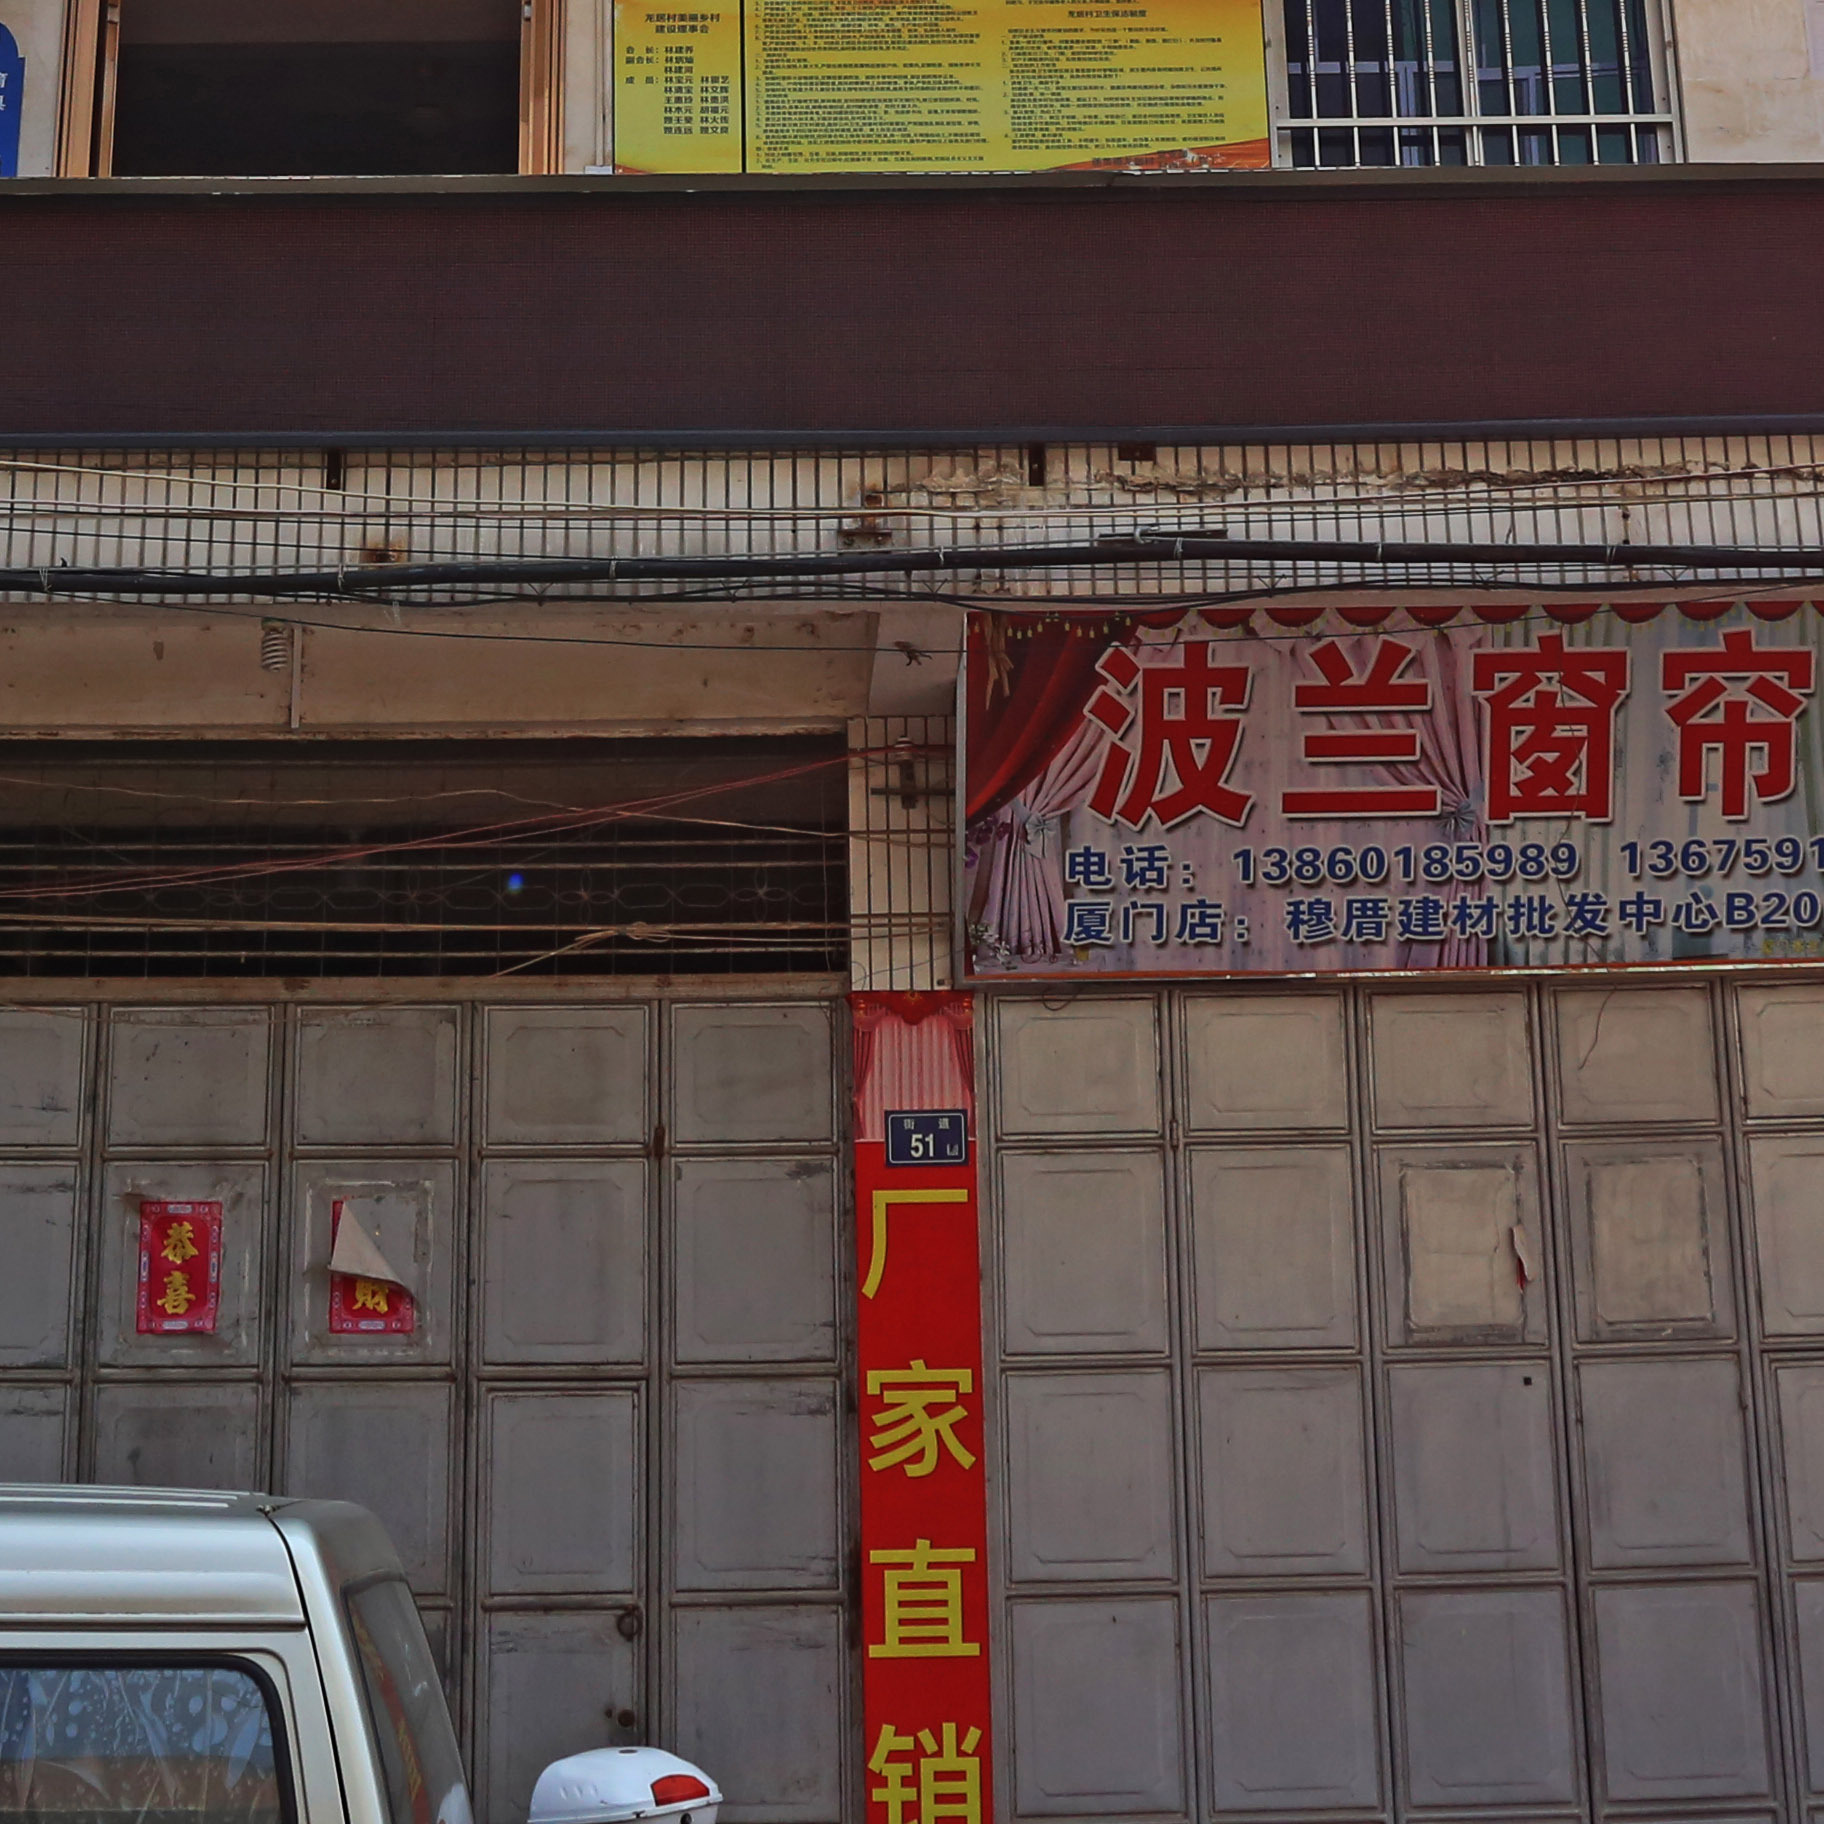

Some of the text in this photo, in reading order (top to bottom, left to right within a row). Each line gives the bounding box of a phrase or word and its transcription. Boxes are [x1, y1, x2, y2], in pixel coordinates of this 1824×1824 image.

[1082, 629, 1816, 832] 波兰窗帘
[1232, 841, 1579, 883] 13860185989
[910, 1132, 935, 1158] 51
[156, 1220, 200, 1316] 恭喜
